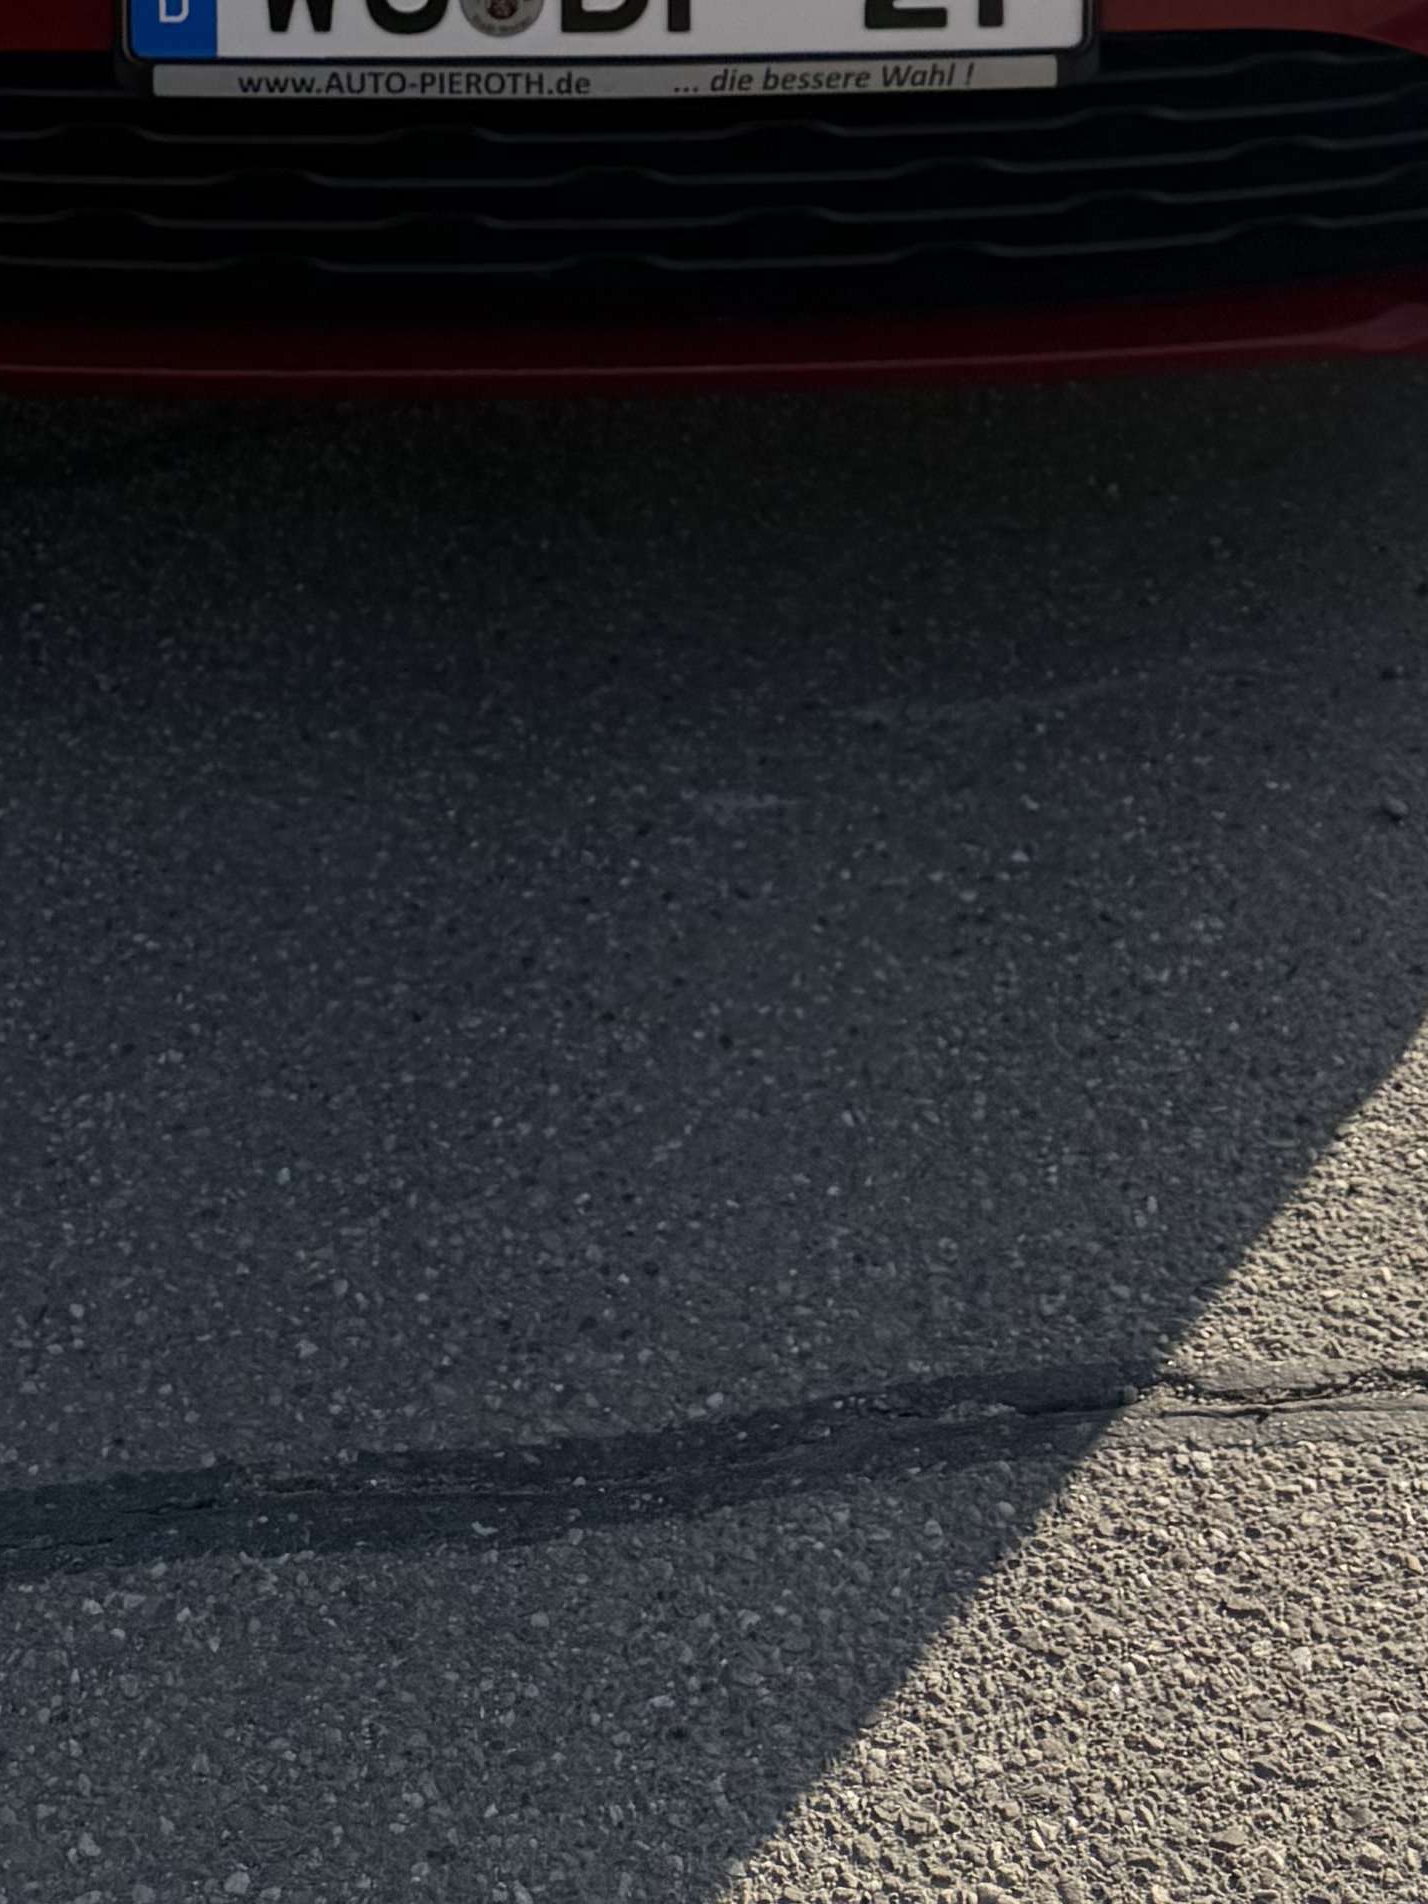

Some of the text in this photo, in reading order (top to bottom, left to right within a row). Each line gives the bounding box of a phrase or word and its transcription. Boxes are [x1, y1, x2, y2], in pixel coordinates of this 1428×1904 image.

[237, 71, 591, 96] www.AUTO-PIEROTH.de
[710, 68, 754, 92] die
[762, 67, 871, 91] bessere
[881, 62, 956, 88] Wahl
